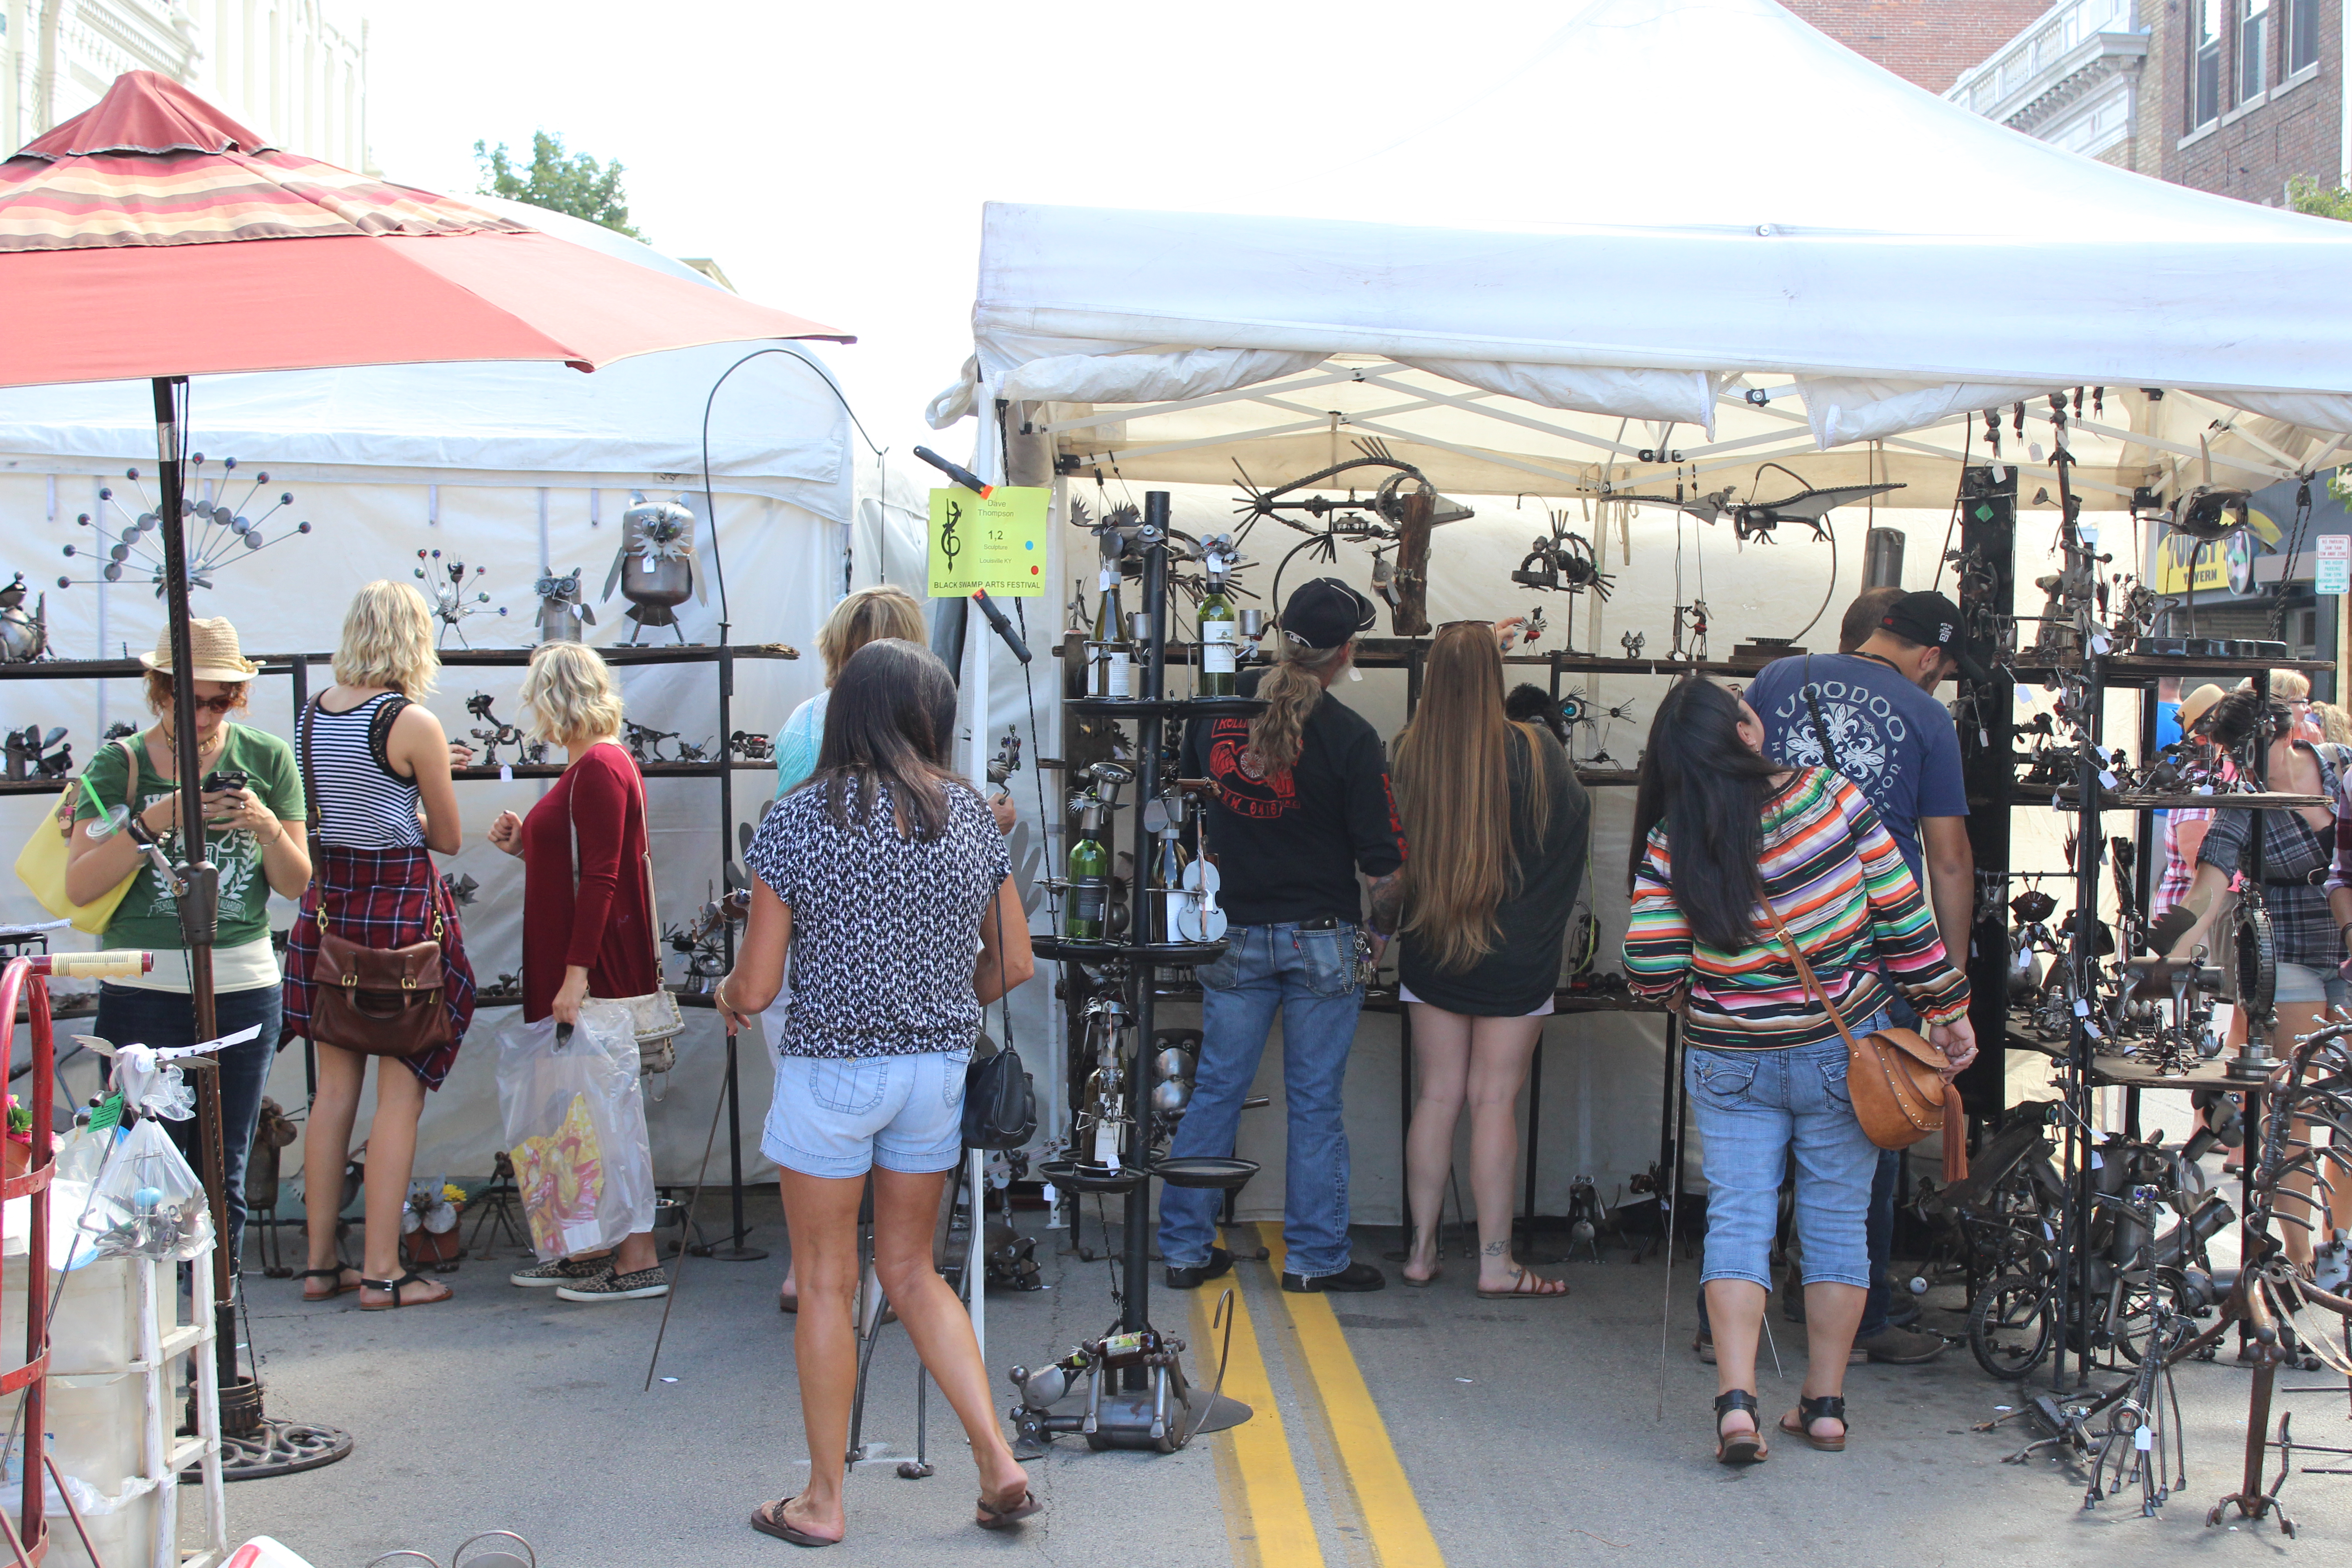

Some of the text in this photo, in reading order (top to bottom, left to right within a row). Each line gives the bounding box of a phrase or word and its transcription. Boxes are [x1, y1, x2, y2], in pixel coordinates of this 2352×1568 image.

[978, 509, 1014, 517] Thompson
[988, 530, 1003, 541] 1,2
[2184, 568, 2217, 584] TVERN
[1939, 633, 1950, 642] GO
[1775, 680, 1907, 742] VOODOO
[1250, 801, 1277, 815] OHIO
